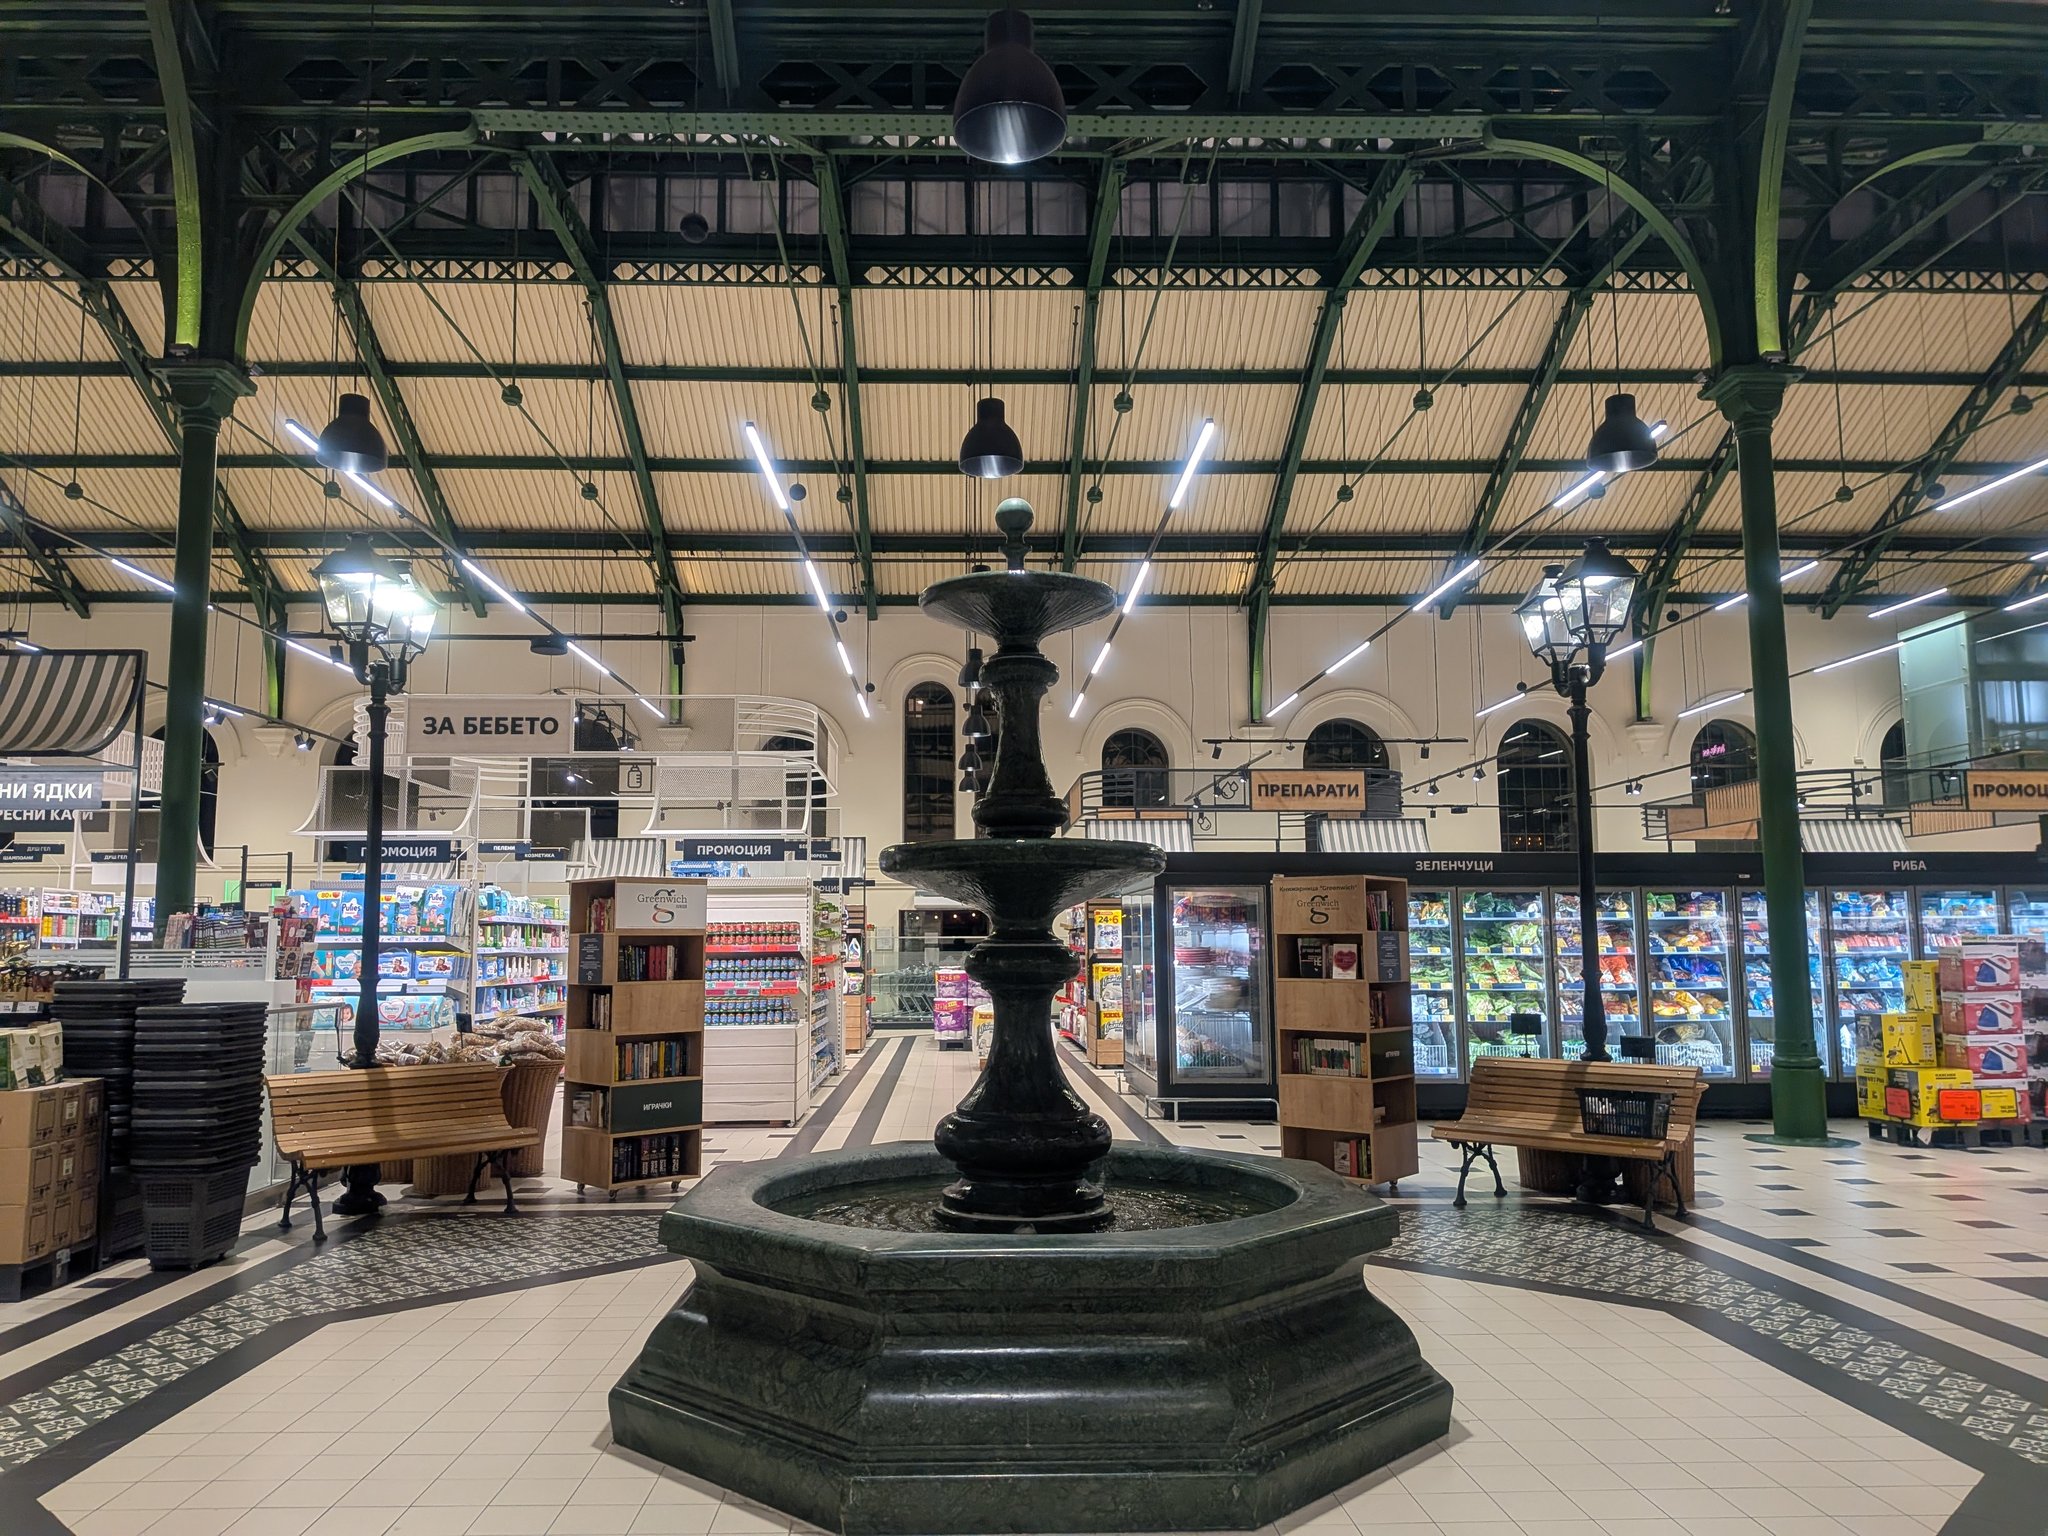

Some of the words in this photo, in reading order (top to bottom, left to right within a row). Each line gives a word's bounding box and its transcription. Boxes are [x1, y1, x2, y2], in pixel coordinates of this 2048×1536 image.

[423, 717, 455, 735] ЗА
[463, 716, 559, 735] БЕБЕТО
[33, 783, 92, 802] ЯДКИ
[1258, 783, 1359, 798] ПРЕПАРАТИ
[0, 809, 45, 820] ЕСНИ
[361, 847, 437, 858] ПОМОЦИЯ
[697, 845, 771, 856] ПРОМОЦИЯ
[1415, 860, 1494, 872] ЗЕЛЕНЧУЦИ
[1893, 860, 1927, 871] РИБА
[637, 893, 688, 904] Greenwich
[1296, 899, 1339, 908] Greenwich
[643, 1101, 672, 1111] ИГРАЧКИ
